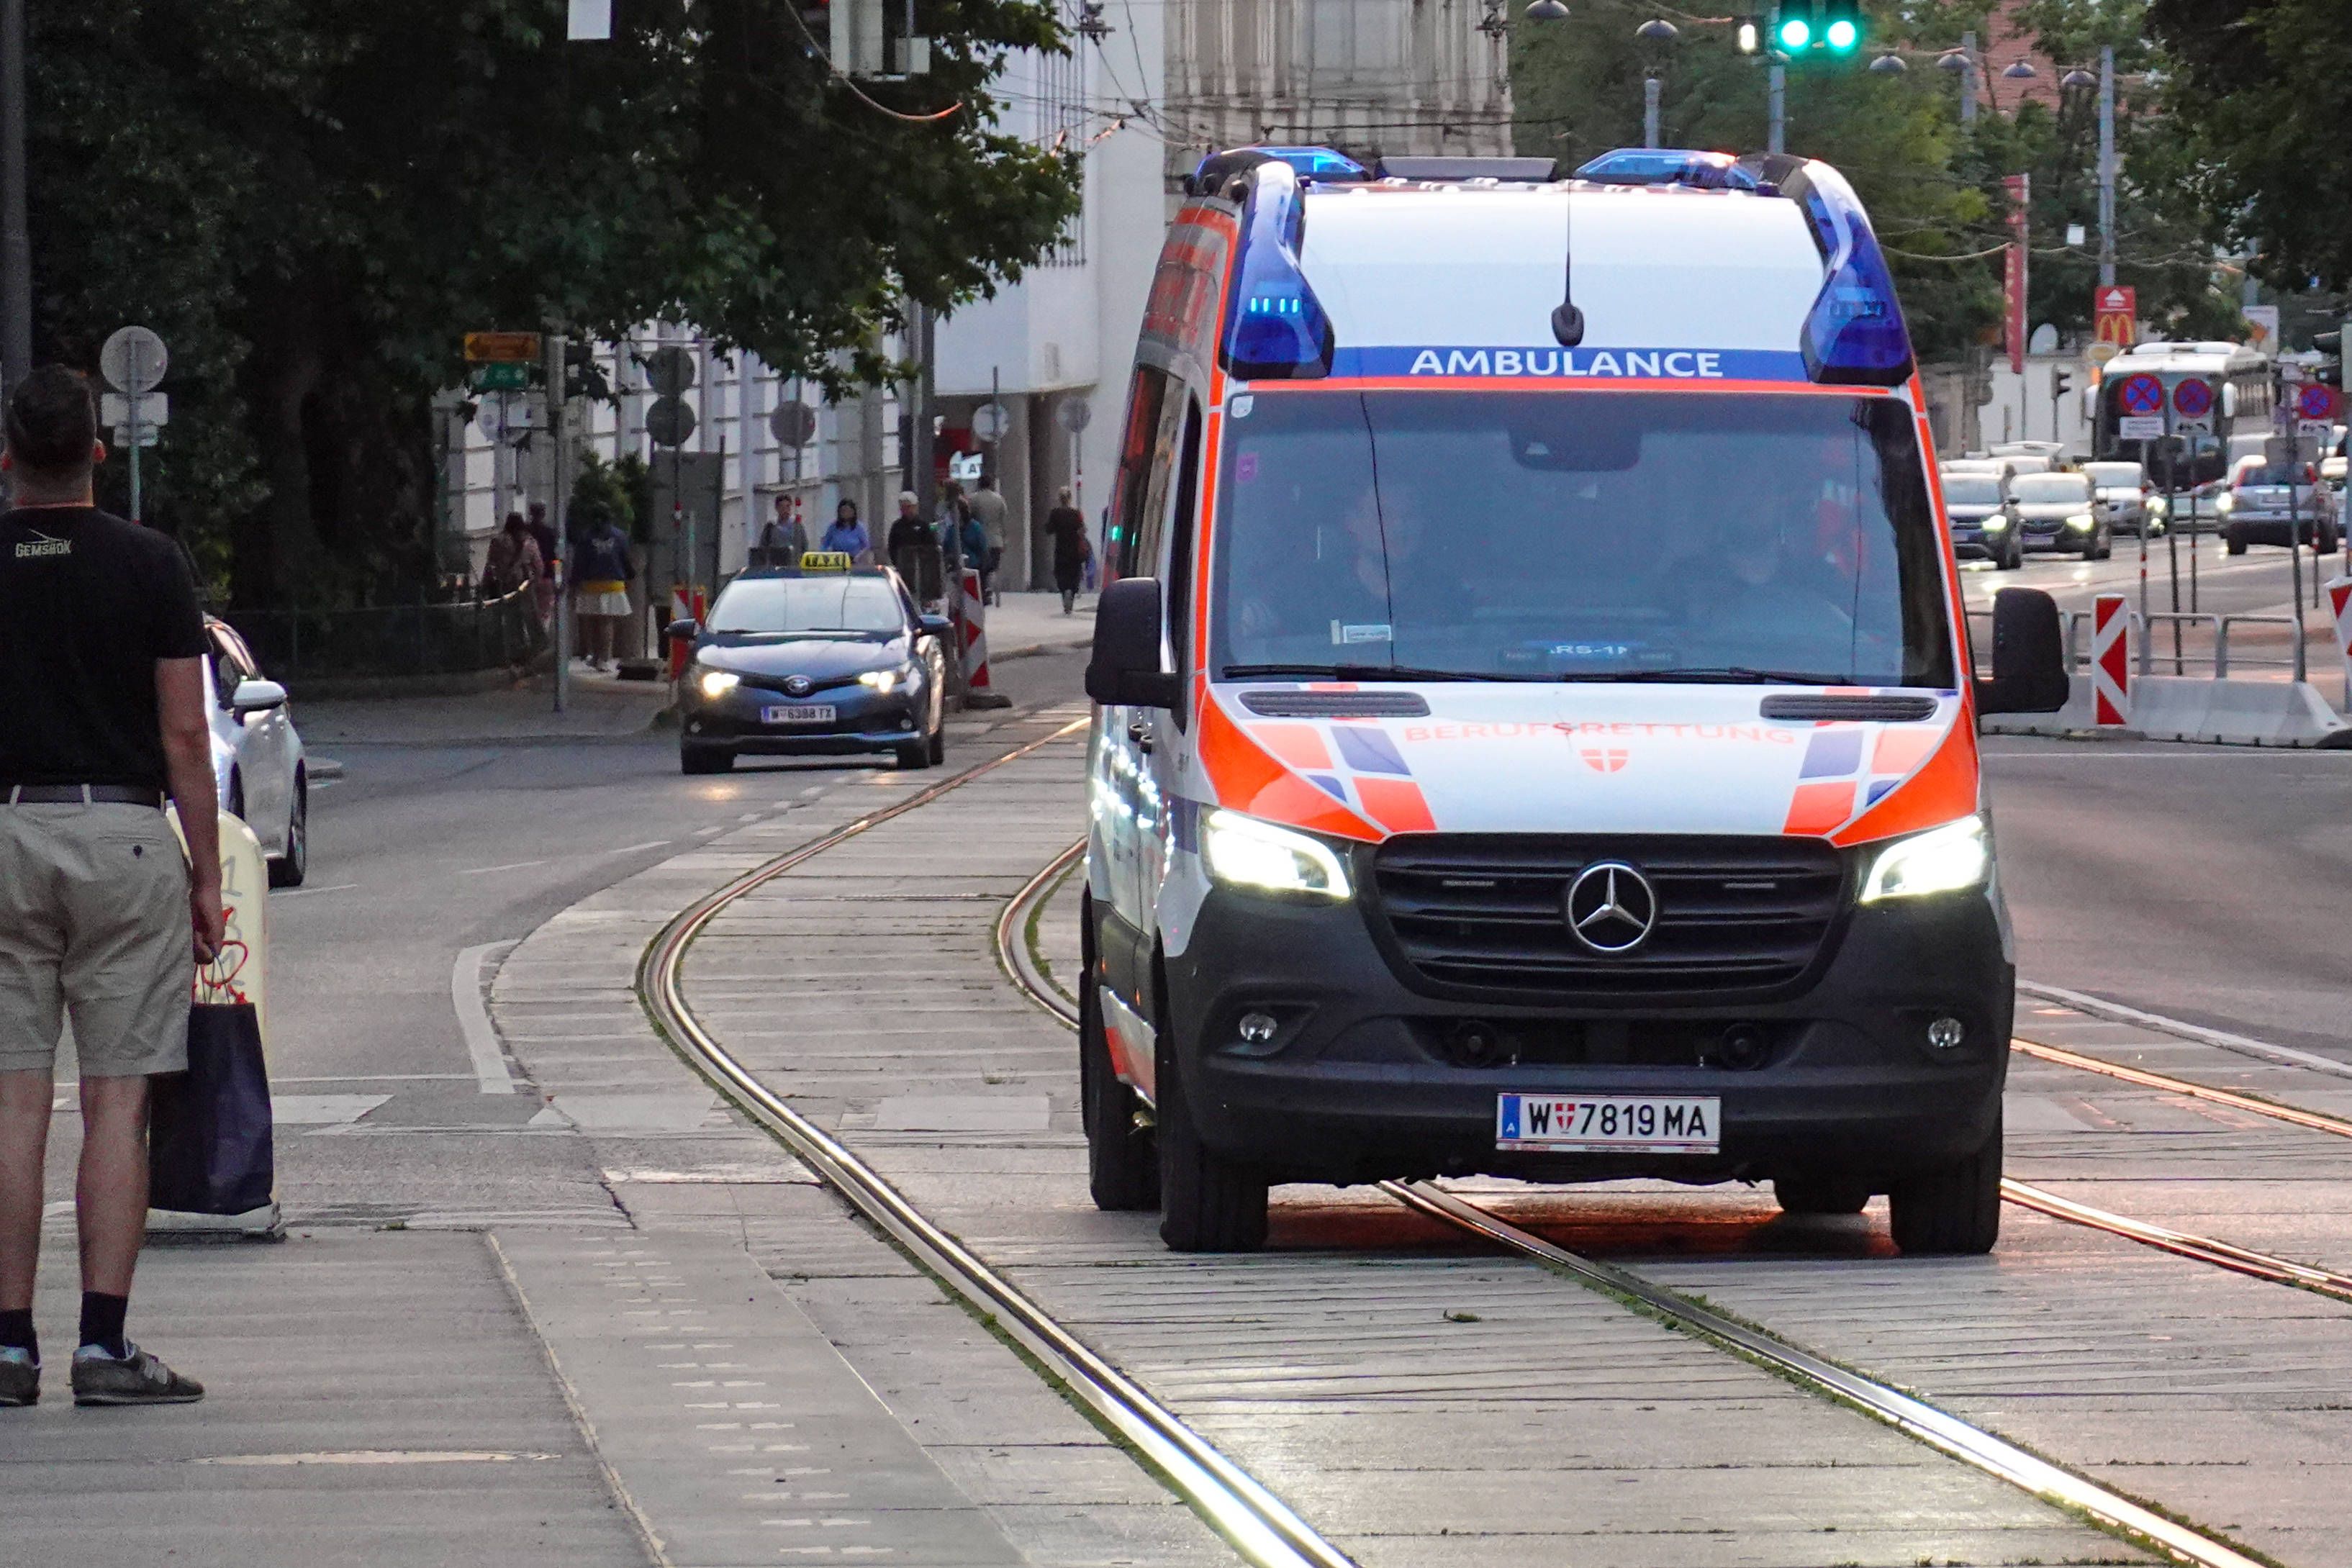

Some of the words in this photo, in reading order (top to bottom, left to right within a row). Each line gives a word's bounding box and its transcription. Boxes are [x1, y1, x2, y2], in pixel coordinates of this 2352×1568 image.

[1410, 350, 1724, 378] AMBULANCE
[805, 553, 846, 568] TAXI
[1405, 722, 1795, 744] BERUFSRETTUNG
[1506, 1123, 1515, 1132] A
[1529, 1102, 1550, 1135] W
[1579, 1103, 1655, 1136] 7819
[1664, 1105, 1706, 1137] MA
